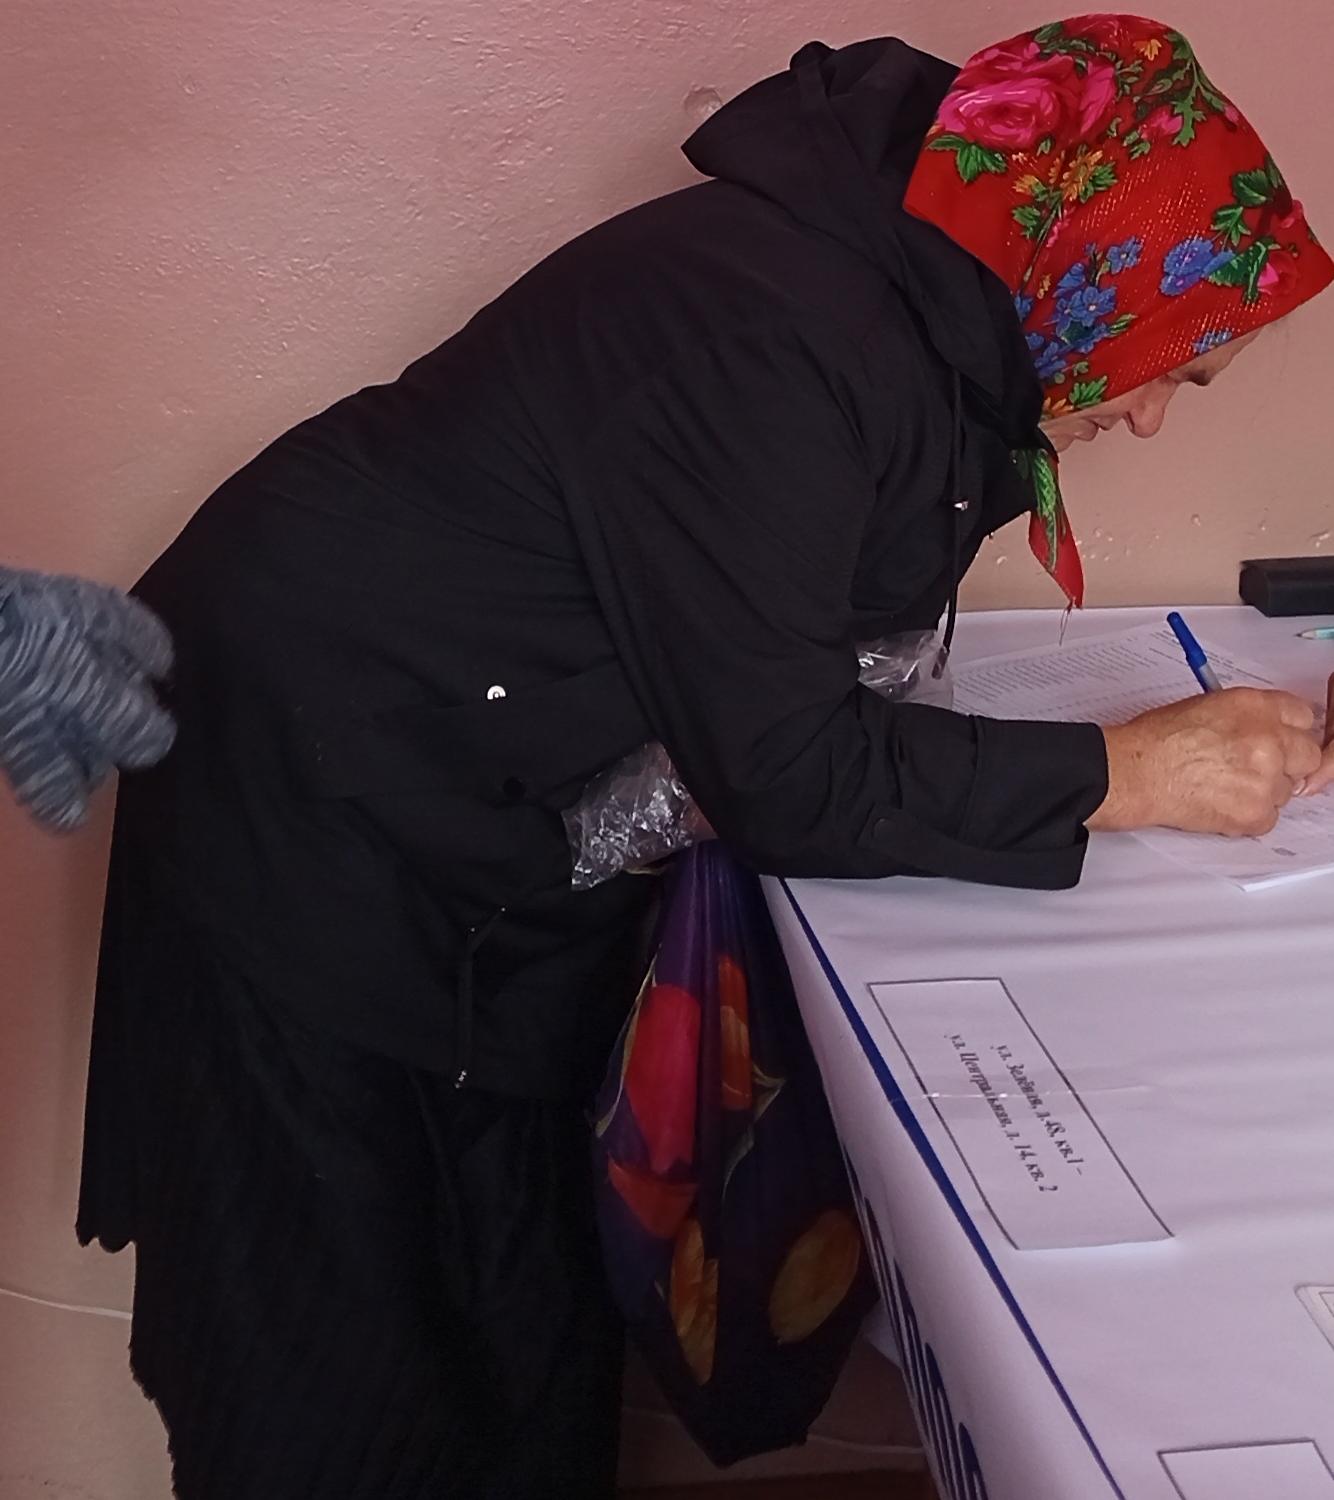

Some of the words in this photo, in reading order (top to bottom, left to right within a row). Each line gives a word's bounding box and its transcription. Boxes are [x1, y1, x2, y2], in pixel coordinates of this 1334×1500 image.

[990, 1045, 1012, 1061] ул.
[943, 1034, 966, 1050] ул.
[959, 1052, 1013, 1128] Центральная,
[1025, 1163, 1045, 1182] кв.
